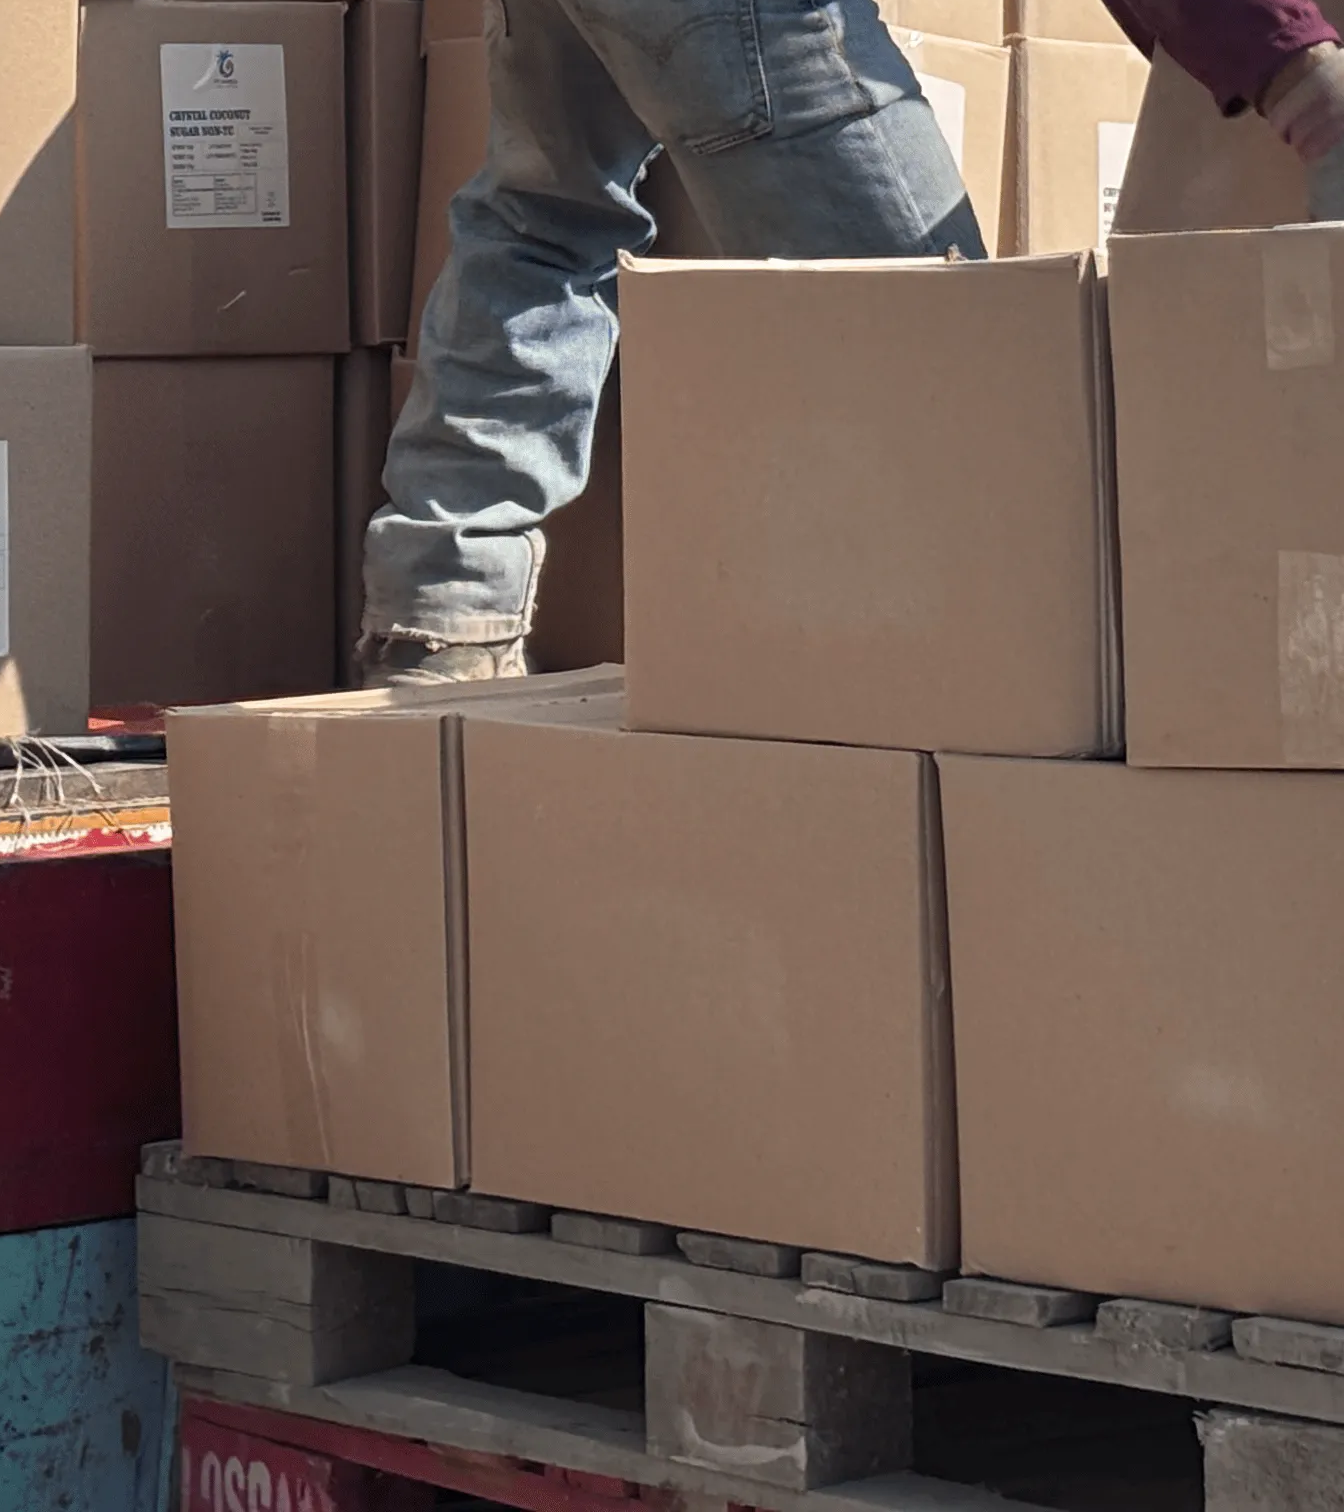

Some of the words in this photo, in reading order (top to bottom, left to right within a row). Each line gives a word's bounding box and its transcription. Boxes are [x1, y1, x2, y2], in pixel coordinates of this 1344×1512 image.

[169, 110, 208, 122] CRYSTAL
[209, 109, 251, 121] COCONUT
[170, 126, 200, 137] SUGAR
